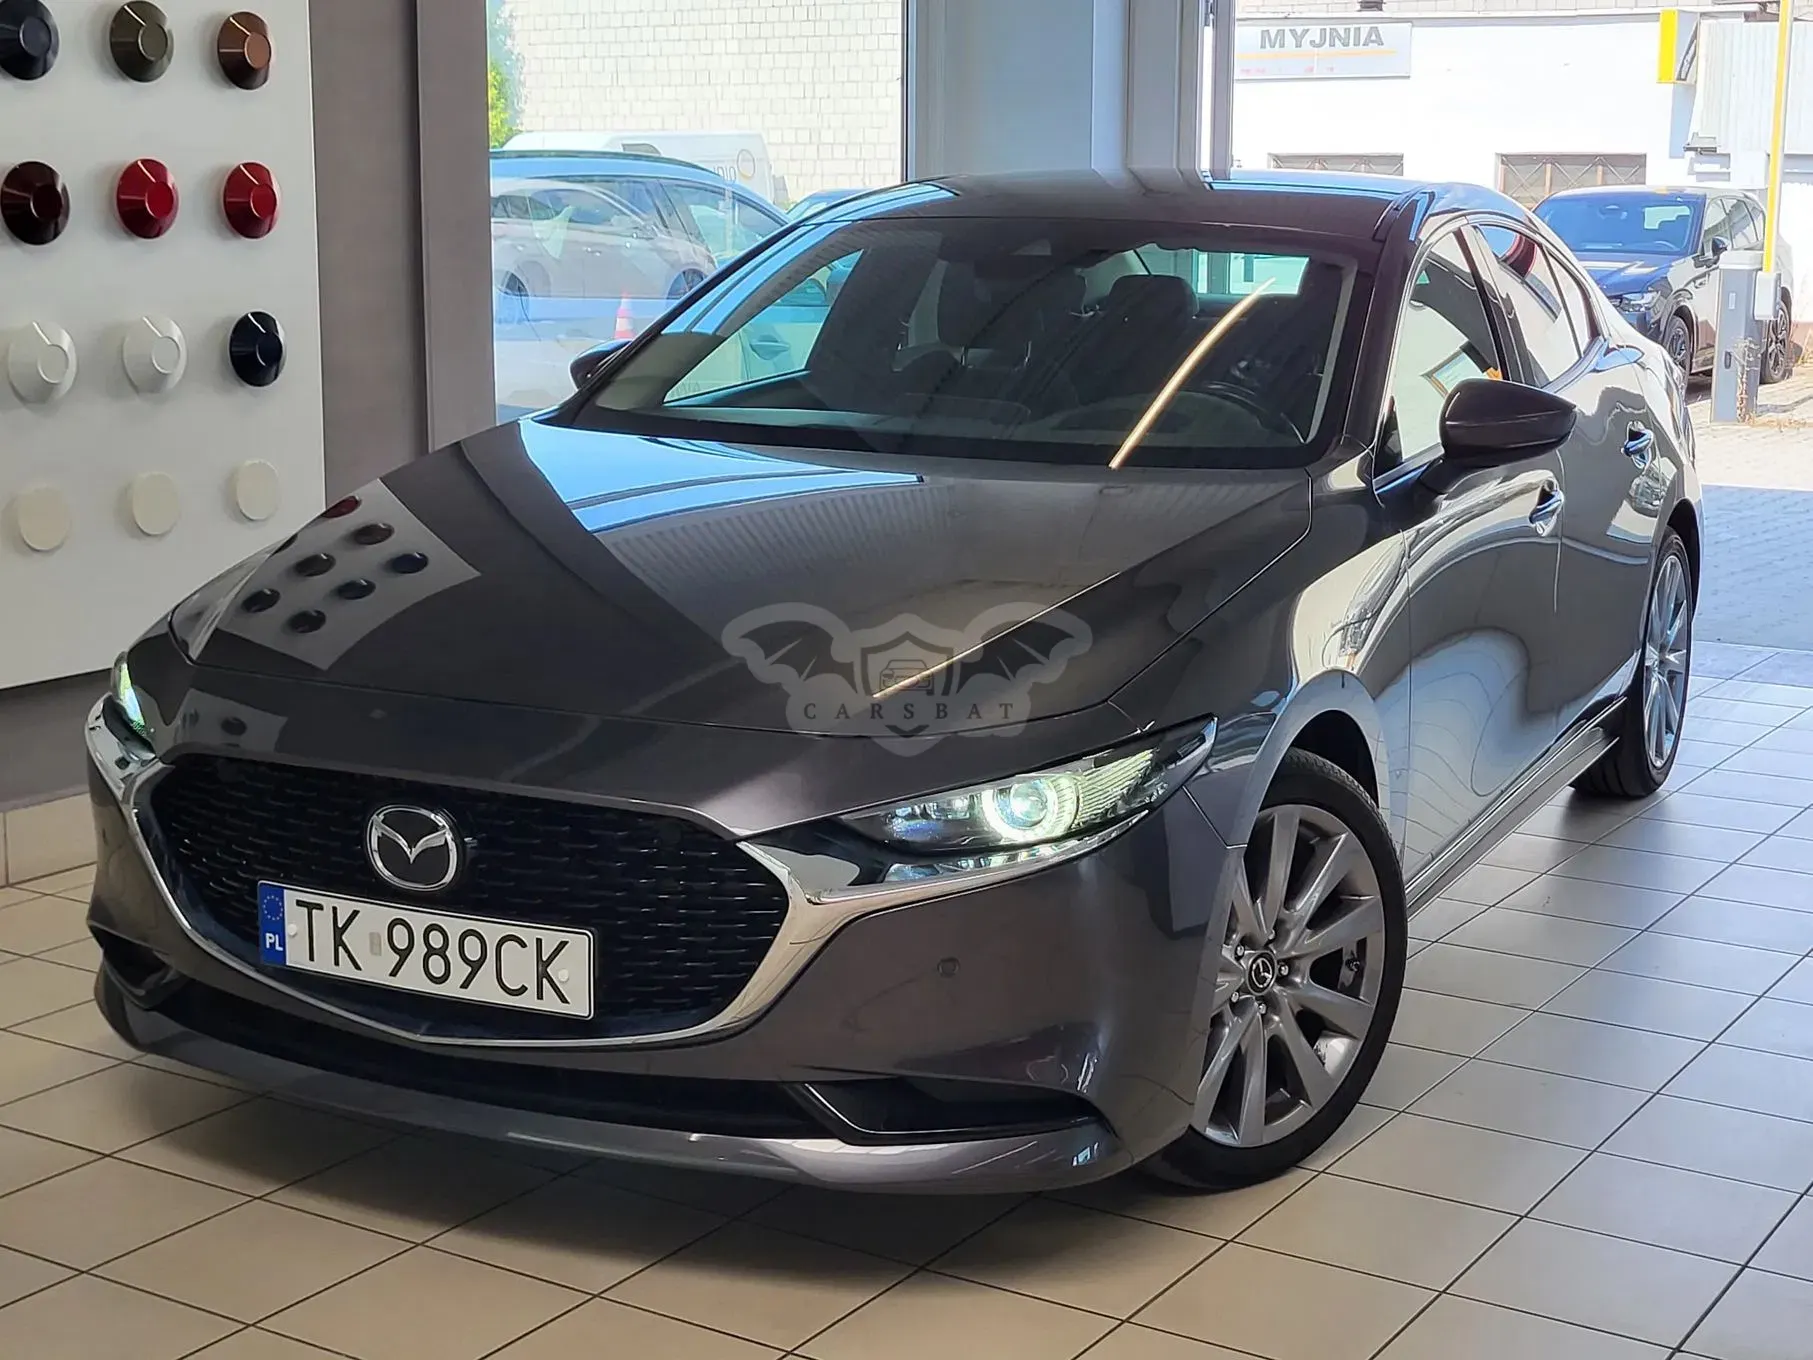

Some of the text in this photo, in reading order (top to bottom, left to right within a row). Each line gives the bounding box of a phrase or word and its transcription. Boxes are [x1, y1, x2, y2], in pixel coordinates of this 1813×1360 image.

[1259, 26, 1385, 49] MYJNIA
[265, 933, 284, 952] PL
[295, 899, 571, 1005] TK 989CK
